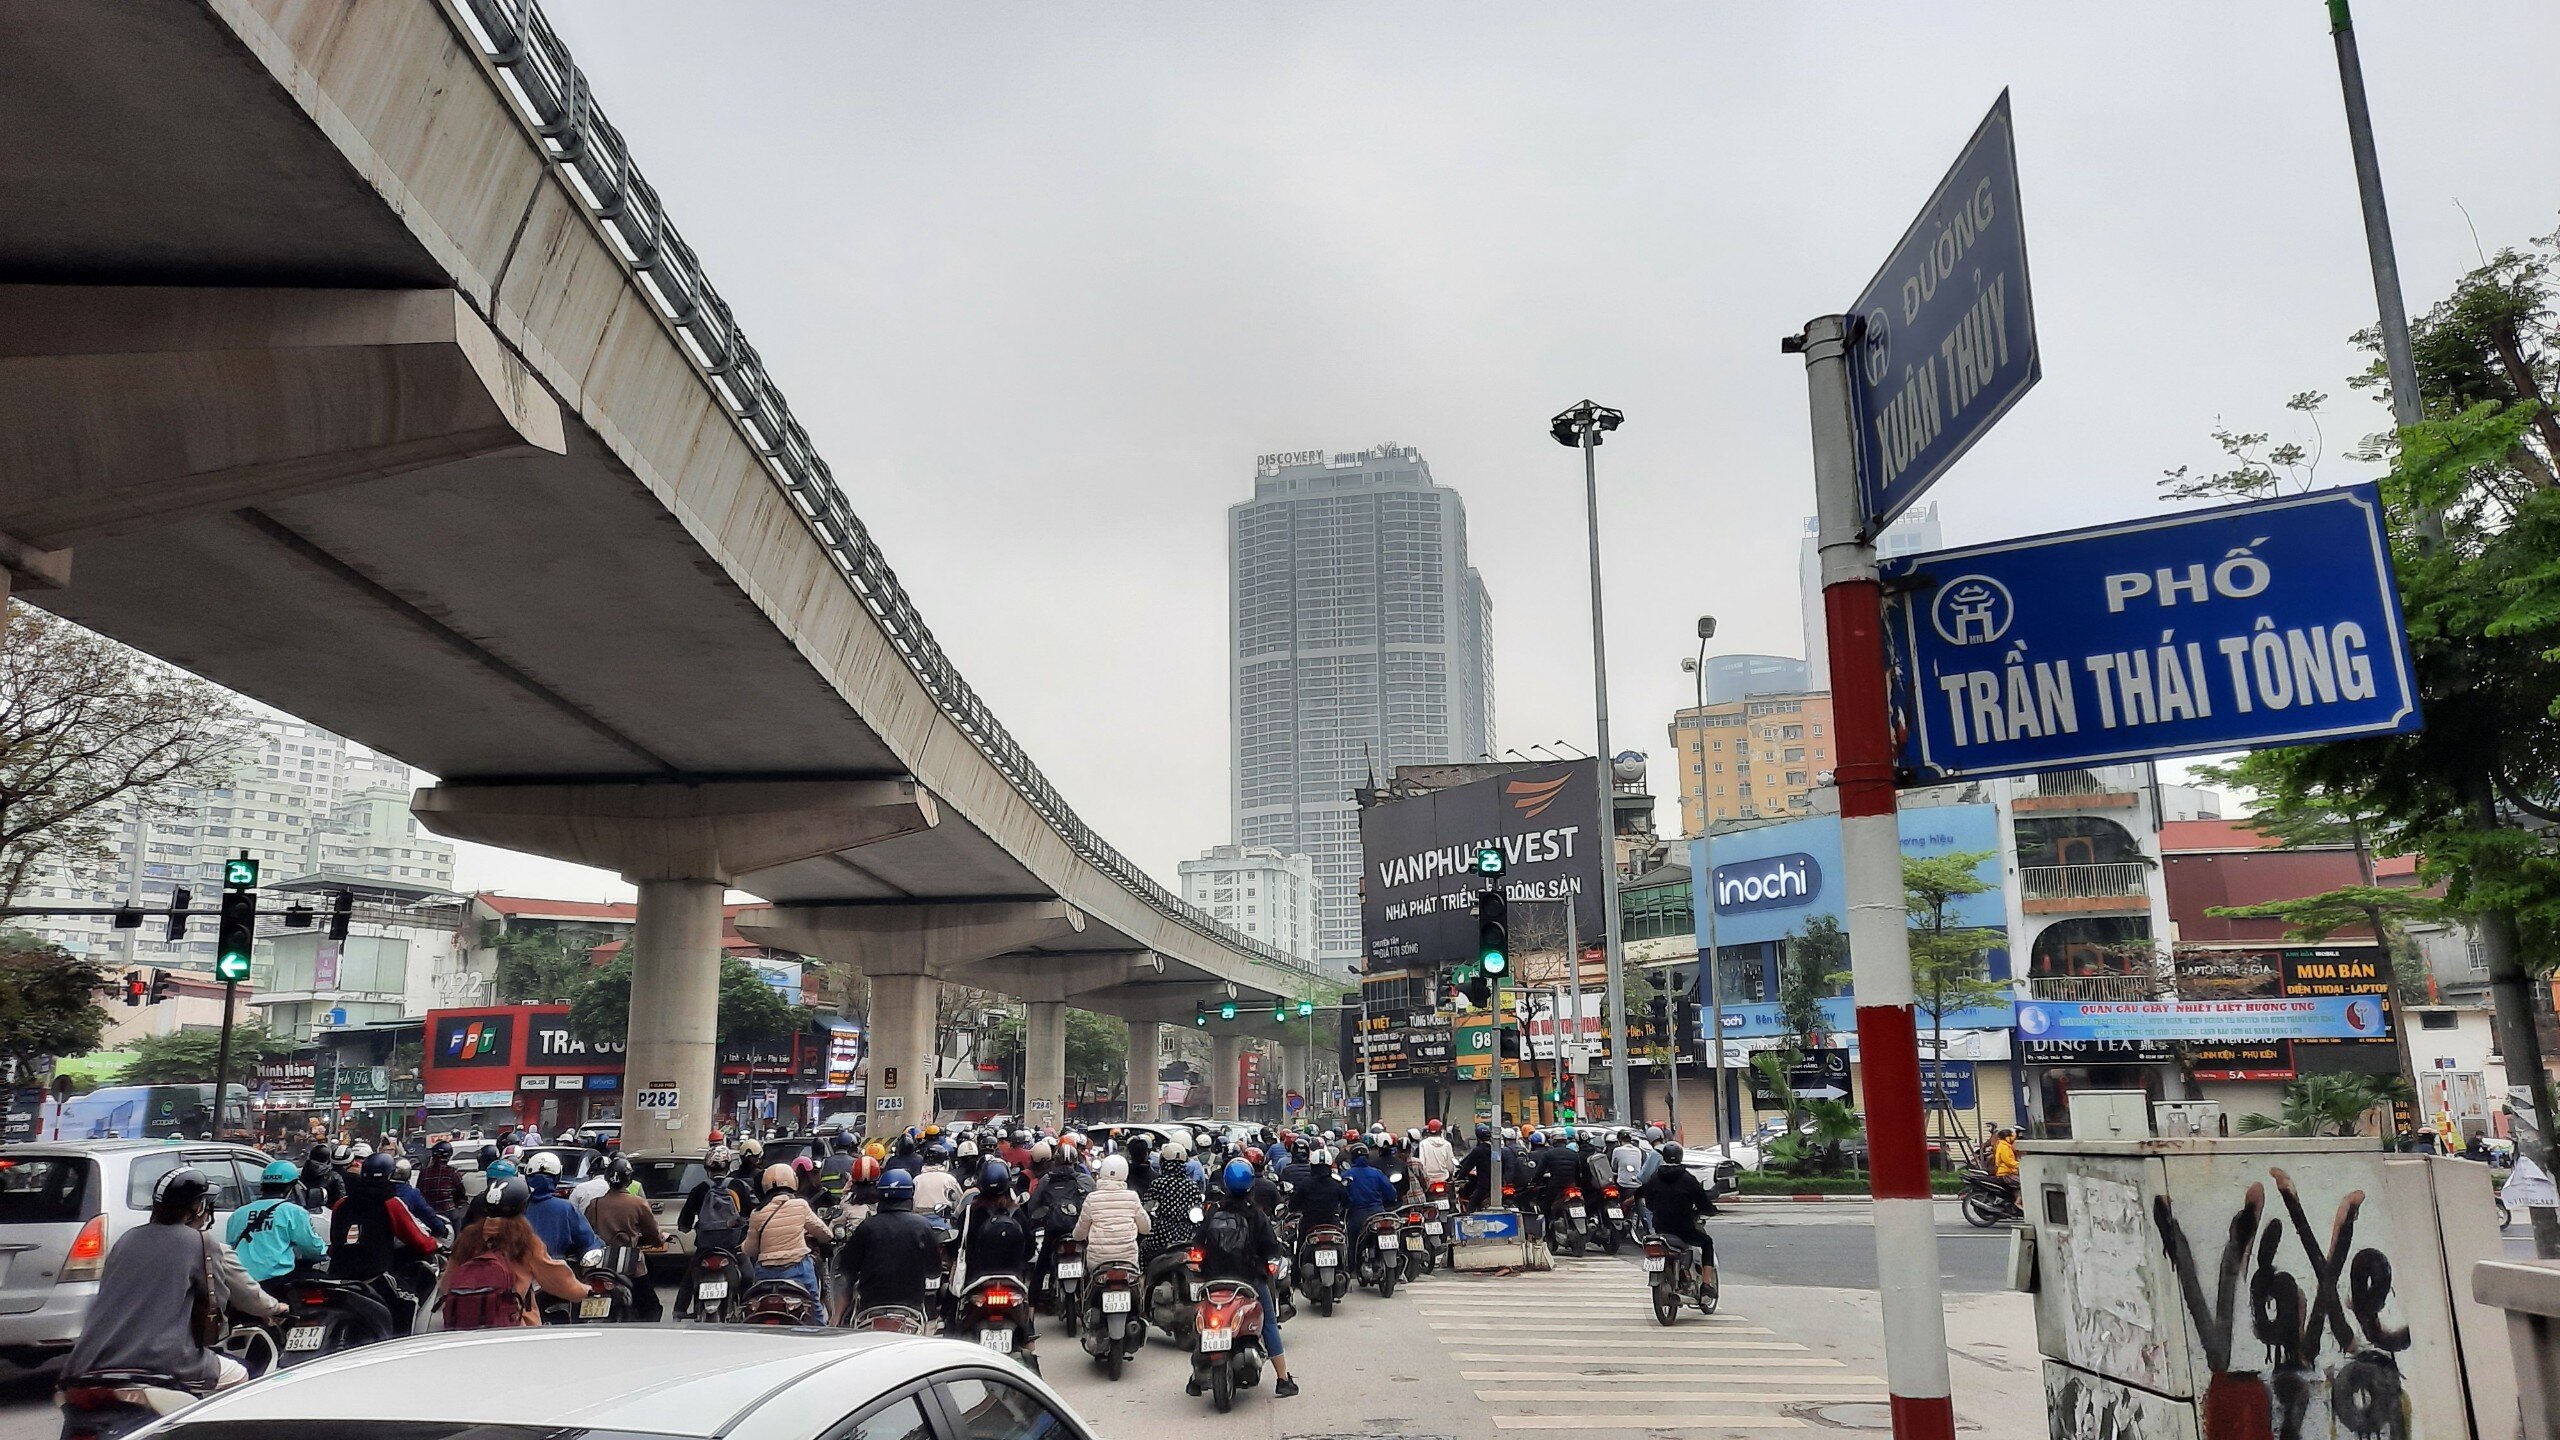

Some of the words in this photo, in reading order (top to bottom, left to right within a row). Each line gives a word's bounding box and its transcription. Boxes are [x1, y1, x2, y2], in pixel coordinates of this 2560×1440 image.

[1903, 176, 1995, 326] ĐƯỜNG
[1875, 355, 1942, 491] XUÂN
[1942, 267, 2009, 419] THỦY
[1257, 450, 1324, 466] DISCOVERY
[2105, 536, 2271, 613] PHỐ
[1940, 639, 2079, 747] TRẦN
[2085, 629, 2213, 728] THÁI
[2219, 616, 2376, 713] TÔNG
[1379, 826, 1579, 888] VANPHU-VEST
[1719, 860, 1807, 906] inochi
[1385, 900, 1408, 922] NHÀ
[1410, 894, 1437, 917] PHÁT
[1549, 873, 1581, 898] SẢN
[2297, 964, 2336, 979] MUA
[2339, 958, 2375, 978] BÁN
[2286, 982, 2312, 997] ĐIỆN
[2314, 984, 2344, 997] THOẠI
[1720, 1014, 1743, 1027] nochi
[2033, 1040, 2087, 1051] DING
[2097, 1040, 2133, 1051] TEA
[257, 1064, 283, 1077] Minh
[2229, 1070, 2246, 1079] 5A
[638, 1091, 678, 1107] P282
[878, 1098, 903, 1109] P283
[1032, 1101, 1050, 1109] P284
